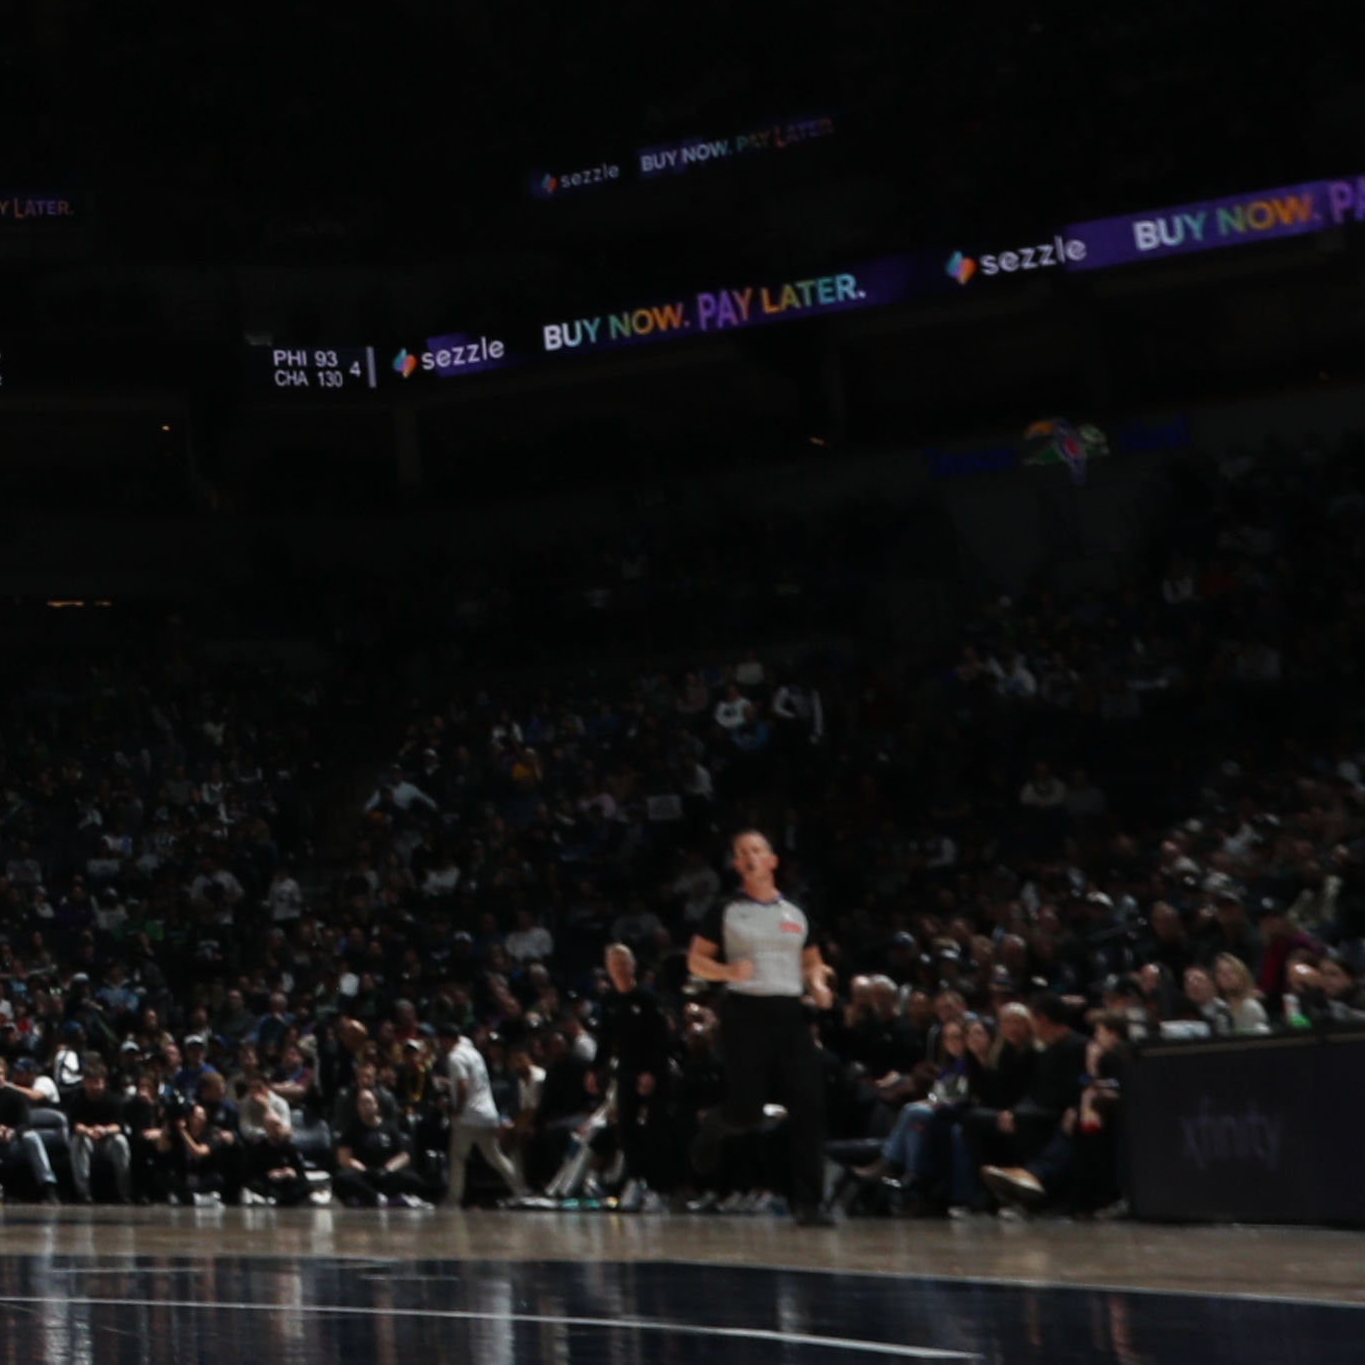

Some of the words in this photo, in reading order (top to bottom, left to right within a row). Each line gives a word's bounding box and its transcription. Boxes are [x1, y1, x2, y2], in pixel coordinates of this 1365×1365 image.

[561, 162, 620, 189] sezzle
[640, 149, 679, 172] BUY
[681, 138, 733, 165] NOW.
[979, 235, 1088, 276] sezzle
[1132, 211, 1208, 252] BUY
[543, 316, 602, 351] BUY
[608, 302, 691, 341] NOW.
[695, 287, 753, 331] PAY
[759, 273, 867, 315] LATER.
[273, 349, 307, 367] PHI
[314, 350, 338, 367] 93
[349, 361, 362, 378] 4
[421, 336, 505, 370] sezzle
[274, 370, 309, 387] CHA
[317, 371, 344, 389] 130
